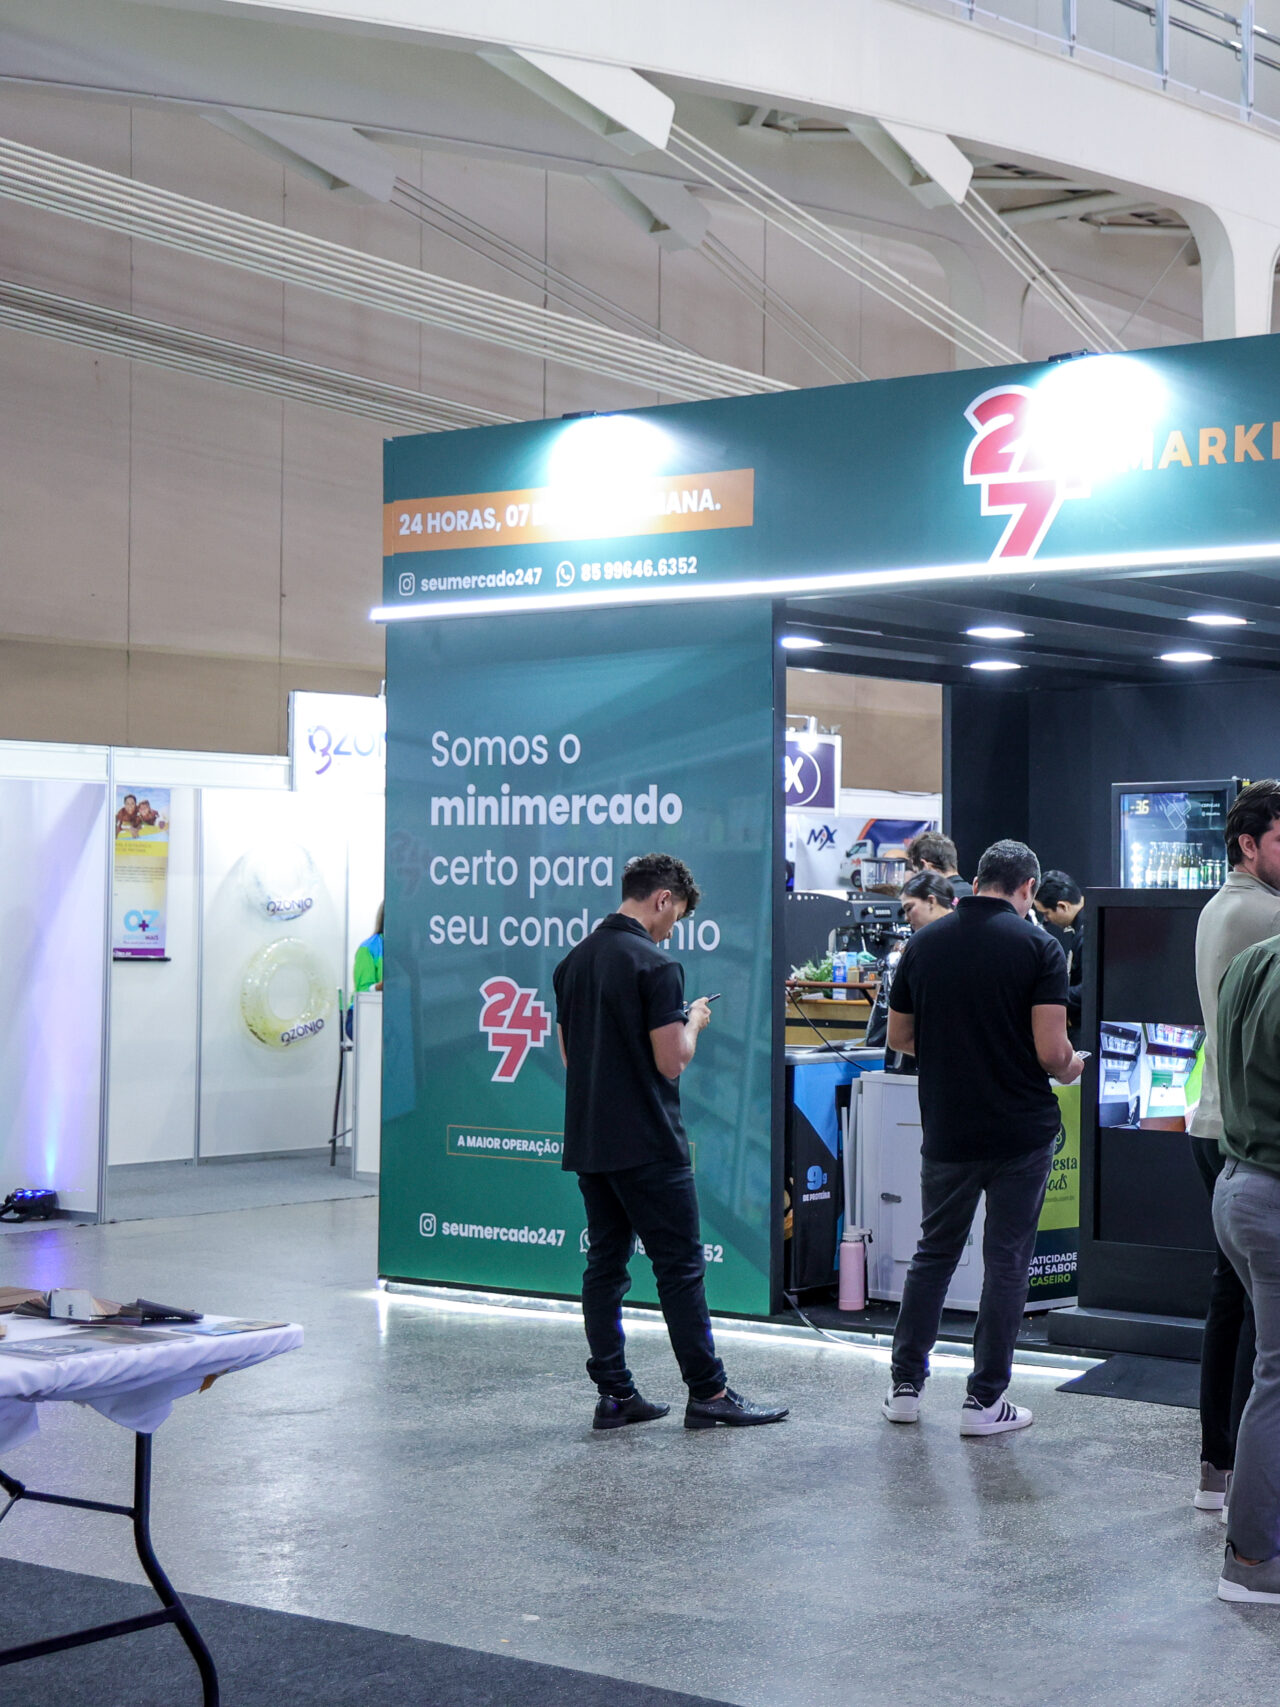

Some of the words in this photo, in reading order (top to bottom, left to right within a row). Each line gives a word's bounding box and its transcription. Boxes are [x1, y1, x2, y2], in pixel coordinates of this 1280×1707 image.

[399, 512, 423, 536] 24
[427, 503, 502, 534] HORAS,
[505, 503, 531, 527] 07
[654, 488, 721, 516] ANA.
[420, 567, 543, 592] seumercado247
[580, 563, 602, 582] 85
[603, 556, 698, 580] 99646.6352
[431, 730, 549, 768] Somos
[559, 733, 581, 765] o
[430, 783, 684, 826] minimercado
[429, 849, 519, 886] certo
[529, 855, 614, 900] para
[429, 915, 489, 946] seu
[499, 908, 721, 952] condnio
[457, 1135, 465, 1147] A
[466, 1135, 501, 1149] MAIOR
[502, 1138, 560, 1156] OPERAÇÃO
[1052, 1157, 1078, 1171] esta
[1047, 1174, 1068, 1192] ods
[441, 1219, 566, 1247] seumercado247
[1030, 1252, 1078, 1266] ATICIDADE
[1044, 1262, 1077, 1275] SABOR
[1030, 1273, 1071, 1287] CASEIRO
